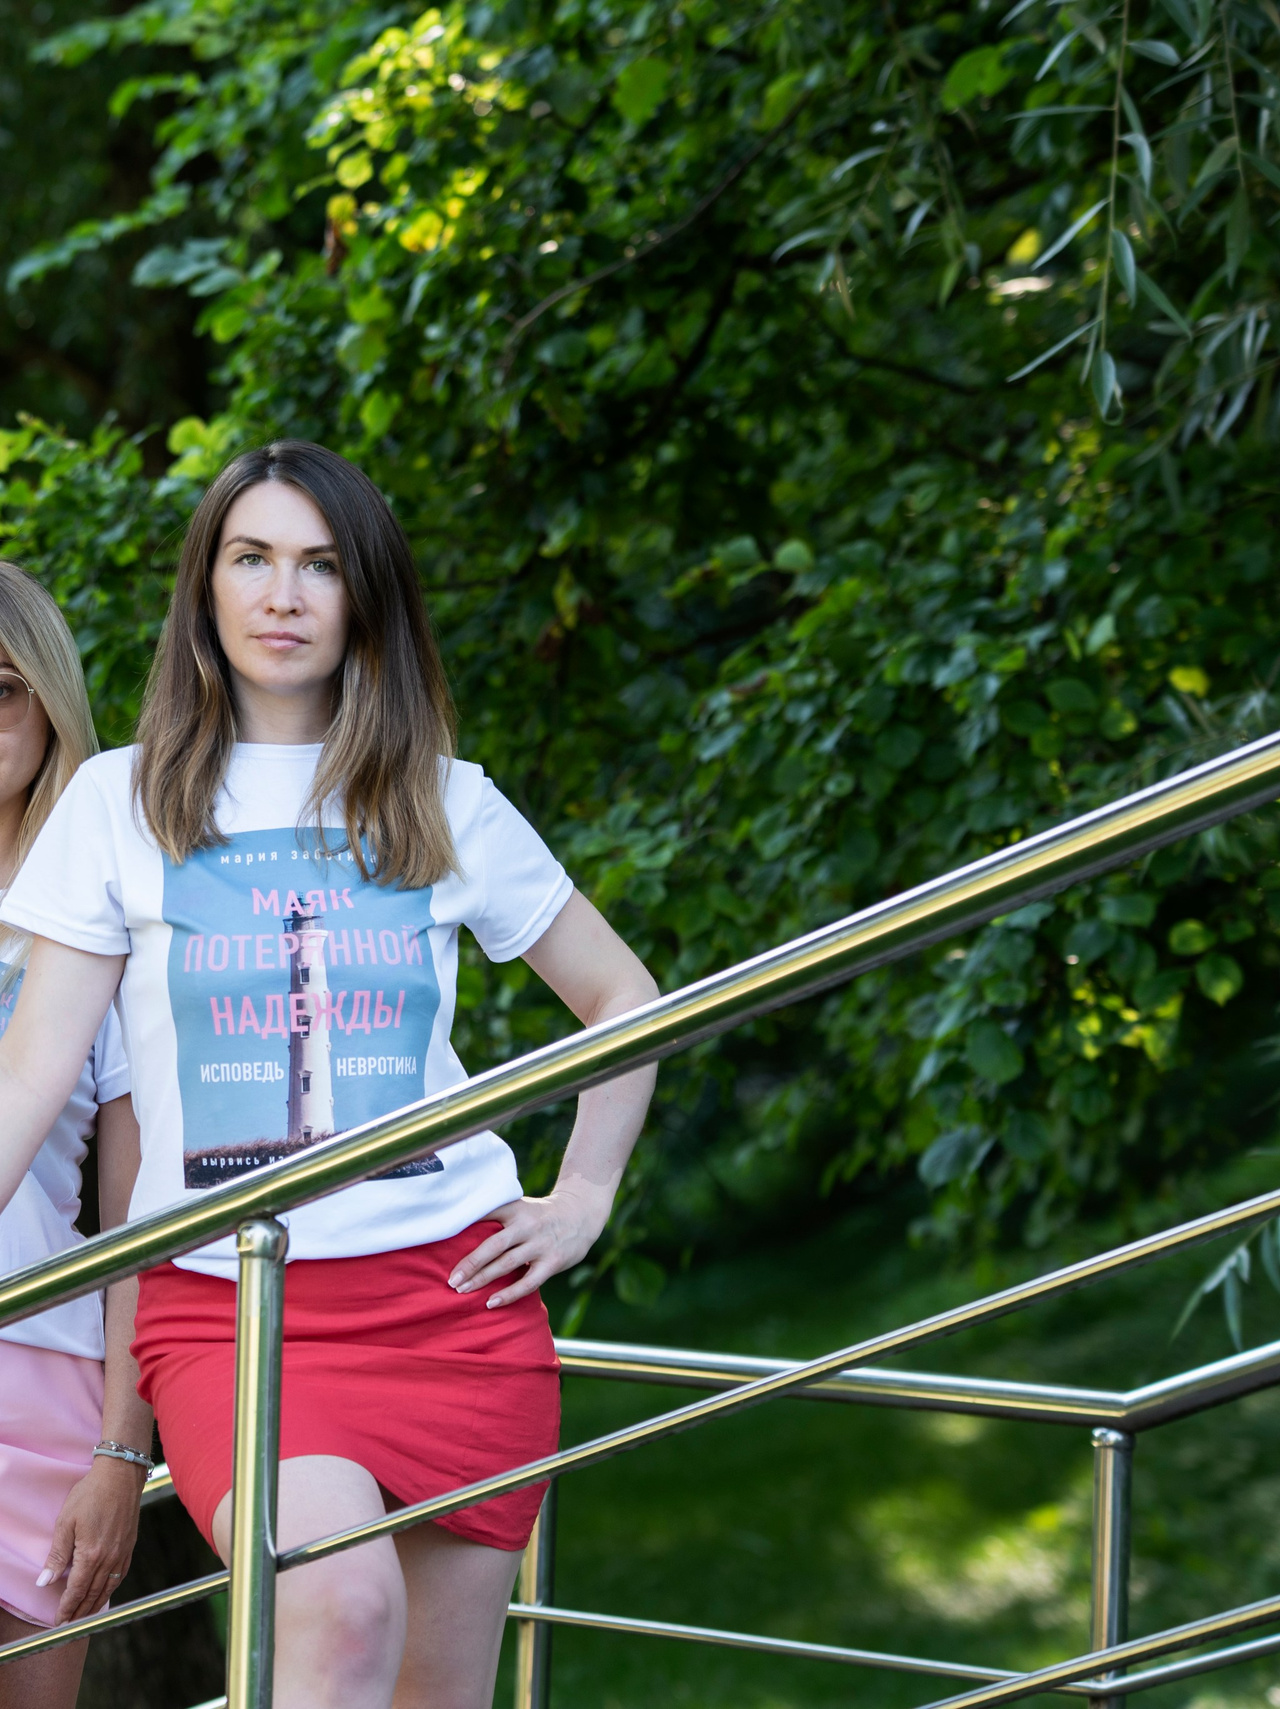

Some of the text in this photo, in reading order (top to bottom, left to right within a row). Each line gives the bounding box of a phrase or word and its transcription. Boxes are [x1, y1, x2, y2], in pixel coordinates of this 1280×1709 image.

[221, 851, 278, 866] мария
[251, 887, 355, 917] МАЯК
[183, 925, 424, 973] ПОТЕРЯННОЙ
[210, 990, 406, 1040] НАДЕЖДЫ
[200, 1056, 418, 1083] ИСПОВЕДЬ НЕВРОТИКА
[202, 1156, 260, 1169] вырвись
